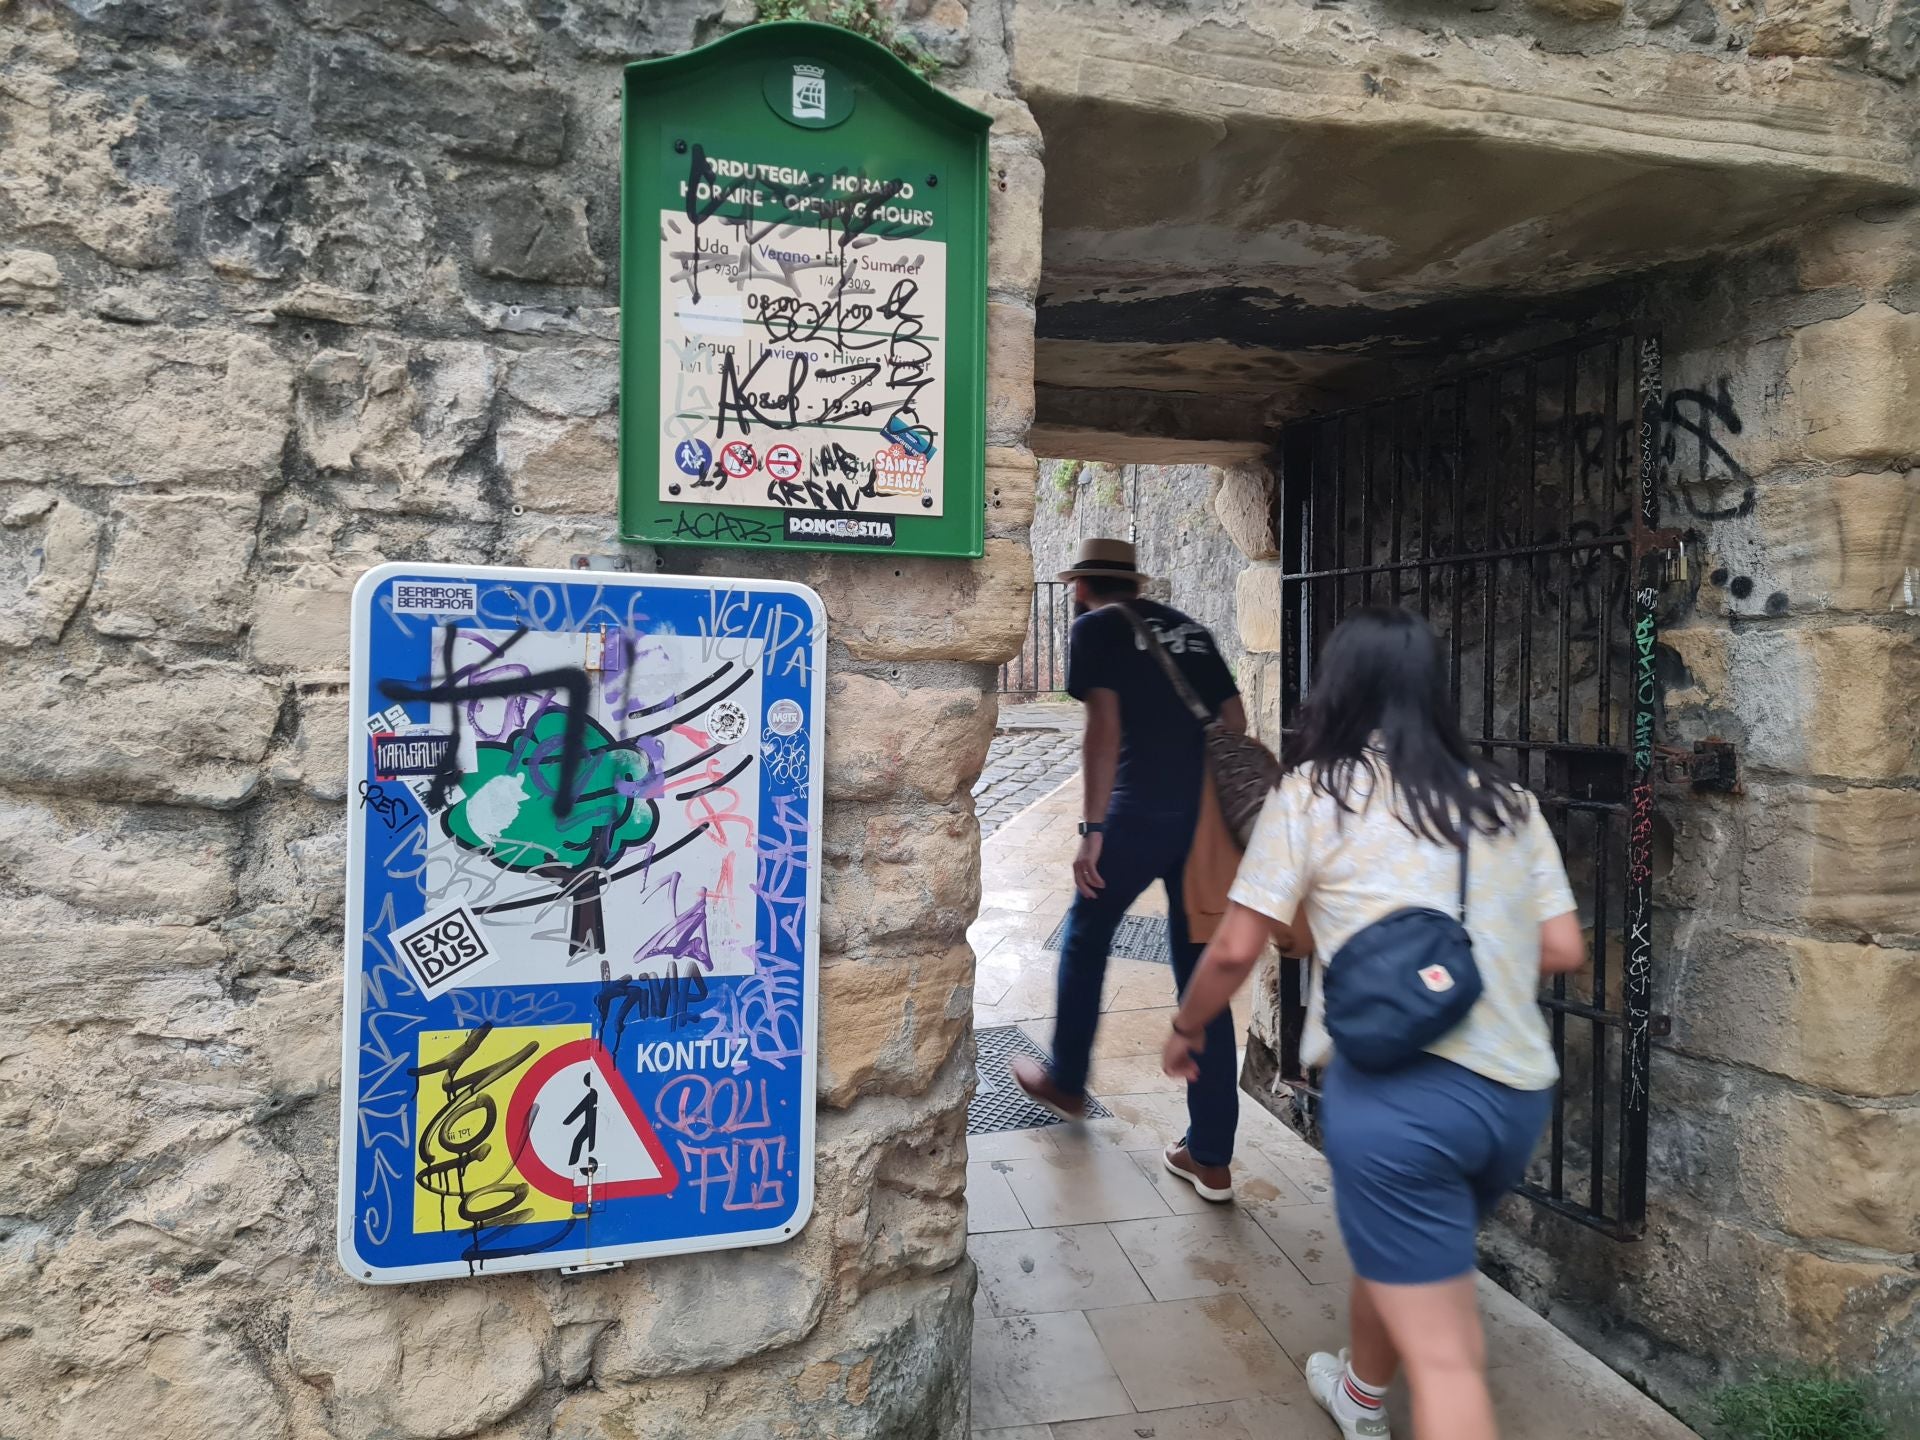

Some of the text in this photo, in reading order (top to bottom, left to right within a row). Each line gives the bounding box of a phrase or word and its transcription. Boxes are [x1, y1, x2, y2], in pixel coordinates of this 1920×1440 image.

[832, 174, 914, 199] HORARO
[873, 205, 934, 227] HOURS
[697, 238, 729, 255] Uda
[714, 263, 739, 277] 9/30
[758, 244, 811, 262] Verano
[861, 255, 921, 275] Summer
[819, 275, 871, 290] 1/4 30/9
[833, 349, 872, 366] Hiver
[410, 920, 465, 958] EXO
[421, 935, 477, 979] DUS
[637, 1038, 748, 1073] KONTUZ
